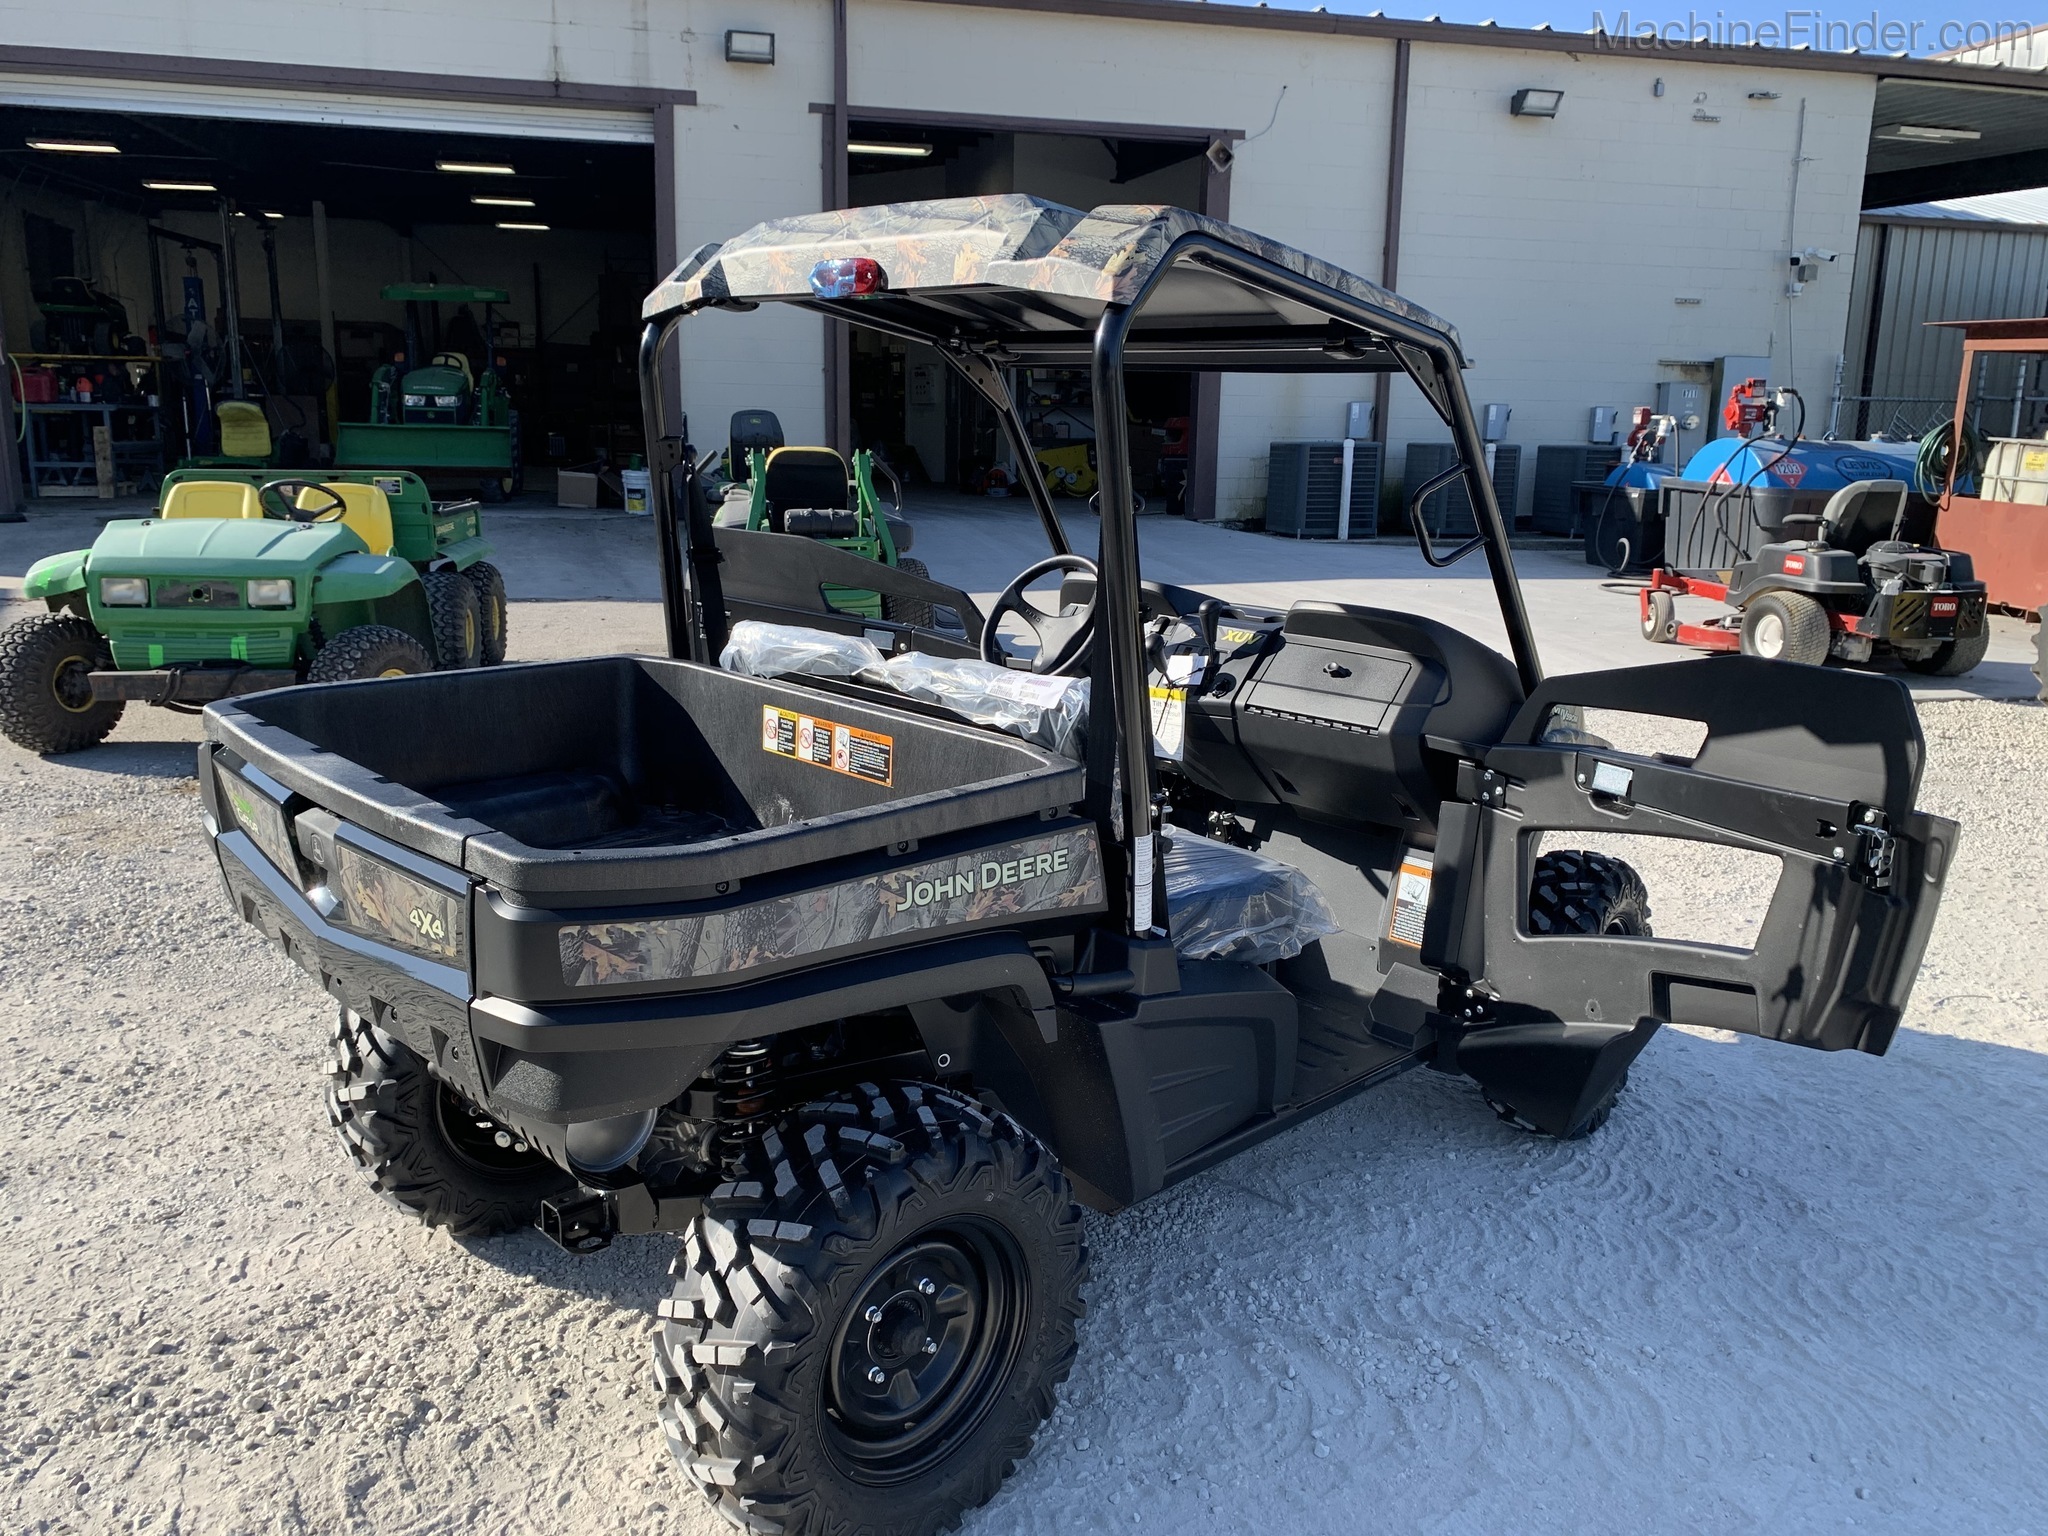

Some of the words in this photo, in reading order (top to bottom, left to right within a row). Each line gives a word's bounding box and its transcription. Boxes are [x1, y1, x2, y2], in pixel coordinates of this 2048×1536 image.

[1775, 463, 1801, 474] 1203
[1841, 460, 1882, 470] LEWIS
[1785, 559, 1803, 570] TORO
[1933, 602, 1956, 612] TORO
[1220, 629, 1263, 645] XUV
[896, 870, 976, 912] JOHN
[980, 848, 1069, 891] DEERE
